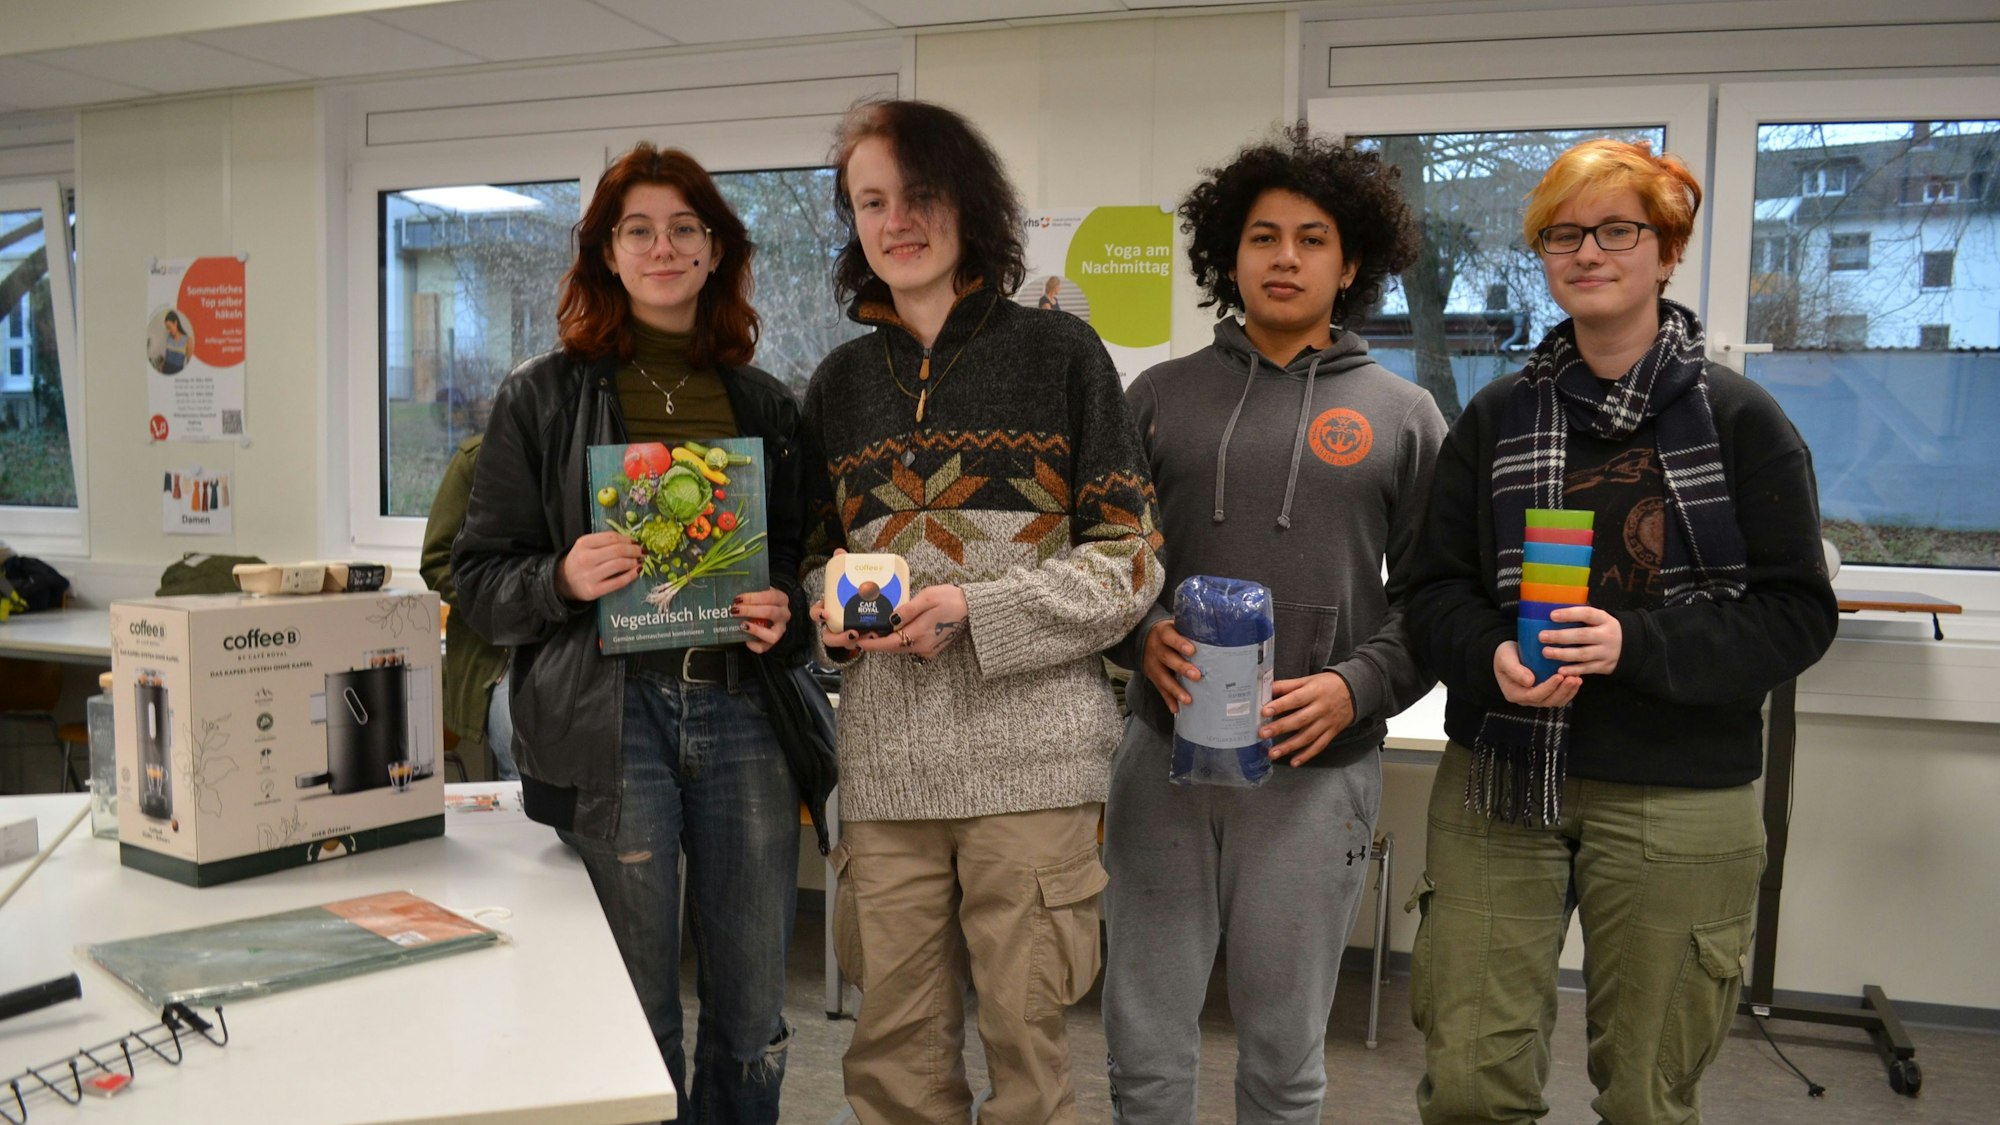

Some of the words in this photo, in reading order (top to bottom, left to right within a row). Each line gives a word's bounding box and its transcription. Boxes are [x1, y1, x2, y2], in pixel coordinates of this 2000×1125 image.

[1104, 244, 1141, 259] Yoga
[1146, 245, 1170, 256] am
[1082, 261, 1170, 276] Nachmittag
[187, 284, 243, 296] Sommerliches
[201, 298, 216, 308] Top
[217, 297, 243, 306] selber
[215, 309, 243, 319] häkeln
[182, 515, 211, 524] Damen
[610, 607, 694, 630] Vegetarisch
[698, 605, 734, 620] kreat
[129, 619, 158, 637] coffee
[223, 628, 285, 651] coffee
[612, 635, 635, 643] Gemüse
[636, 631, 672, 641] überraschend
[672, 629, 705, 637] kombinieren
